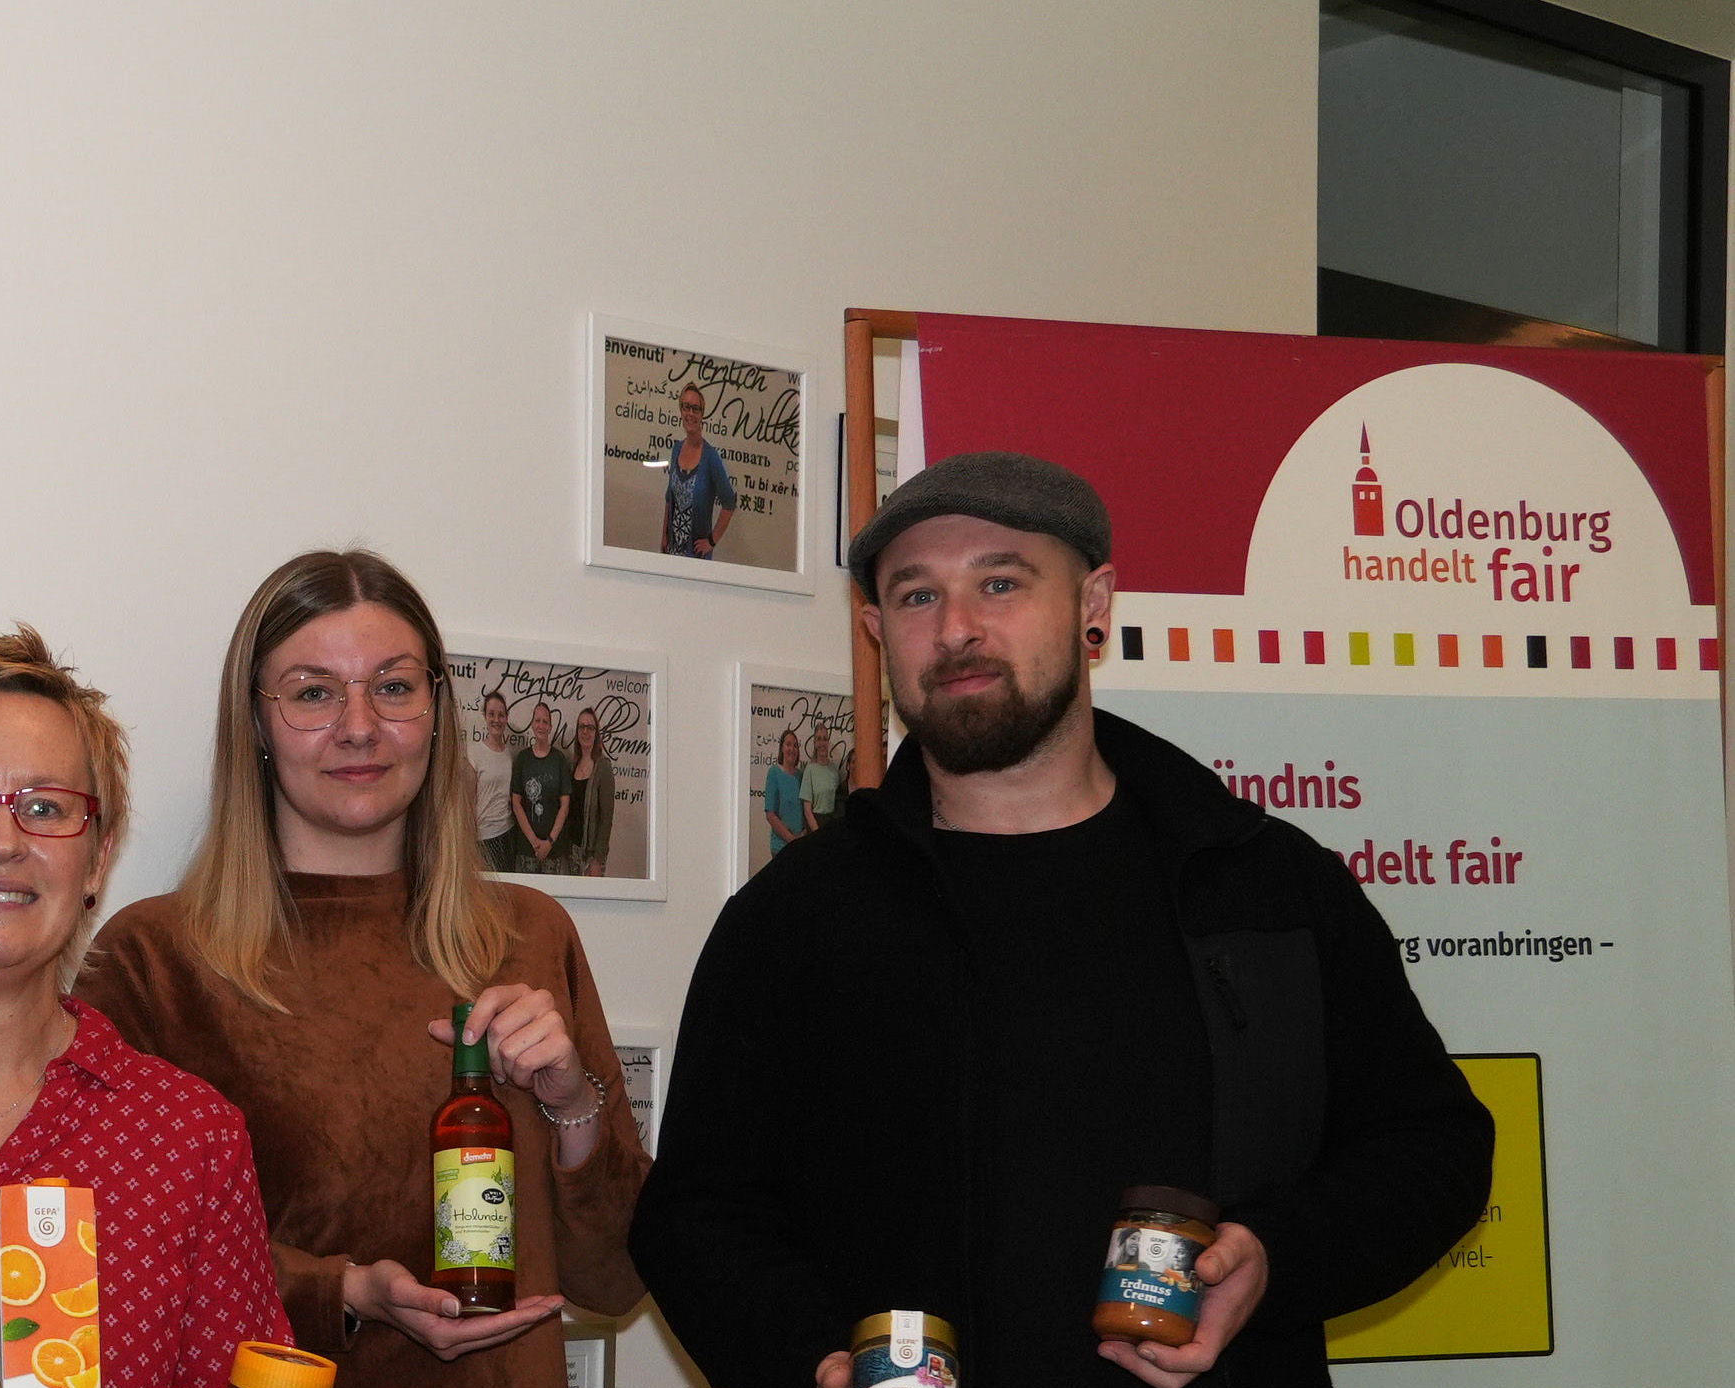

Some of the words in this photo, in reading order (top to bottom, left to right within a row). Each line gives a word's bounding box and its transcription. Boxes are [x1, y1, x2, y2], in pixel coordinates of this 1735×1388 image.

[615, 402, 654, 422] cálida
[714, 446, 771, 468] аловать
[744, 474, 756, 490] Tu
[758, 477, 769, 492] bi
[1395, 497, 1612, 553] Oldenburg
[1343, 545, 1477, 583] handelt
[1487, 545, 1581, 602] fair
[1445, 836, 1523, 885] fair
[1426, 930, 1593, 962] voranbringen
[463, 1152, 493, 1162] demeter
[34, 1207, 57, 1216] GEPA
[453, 1207, 508, 1222] Holunder
[1449, 1244, 1494, 1269] viel-
[1119, 1278, 1172, 1297] Erdnuss
[1123, 1288, 1165, 1305] Creme
